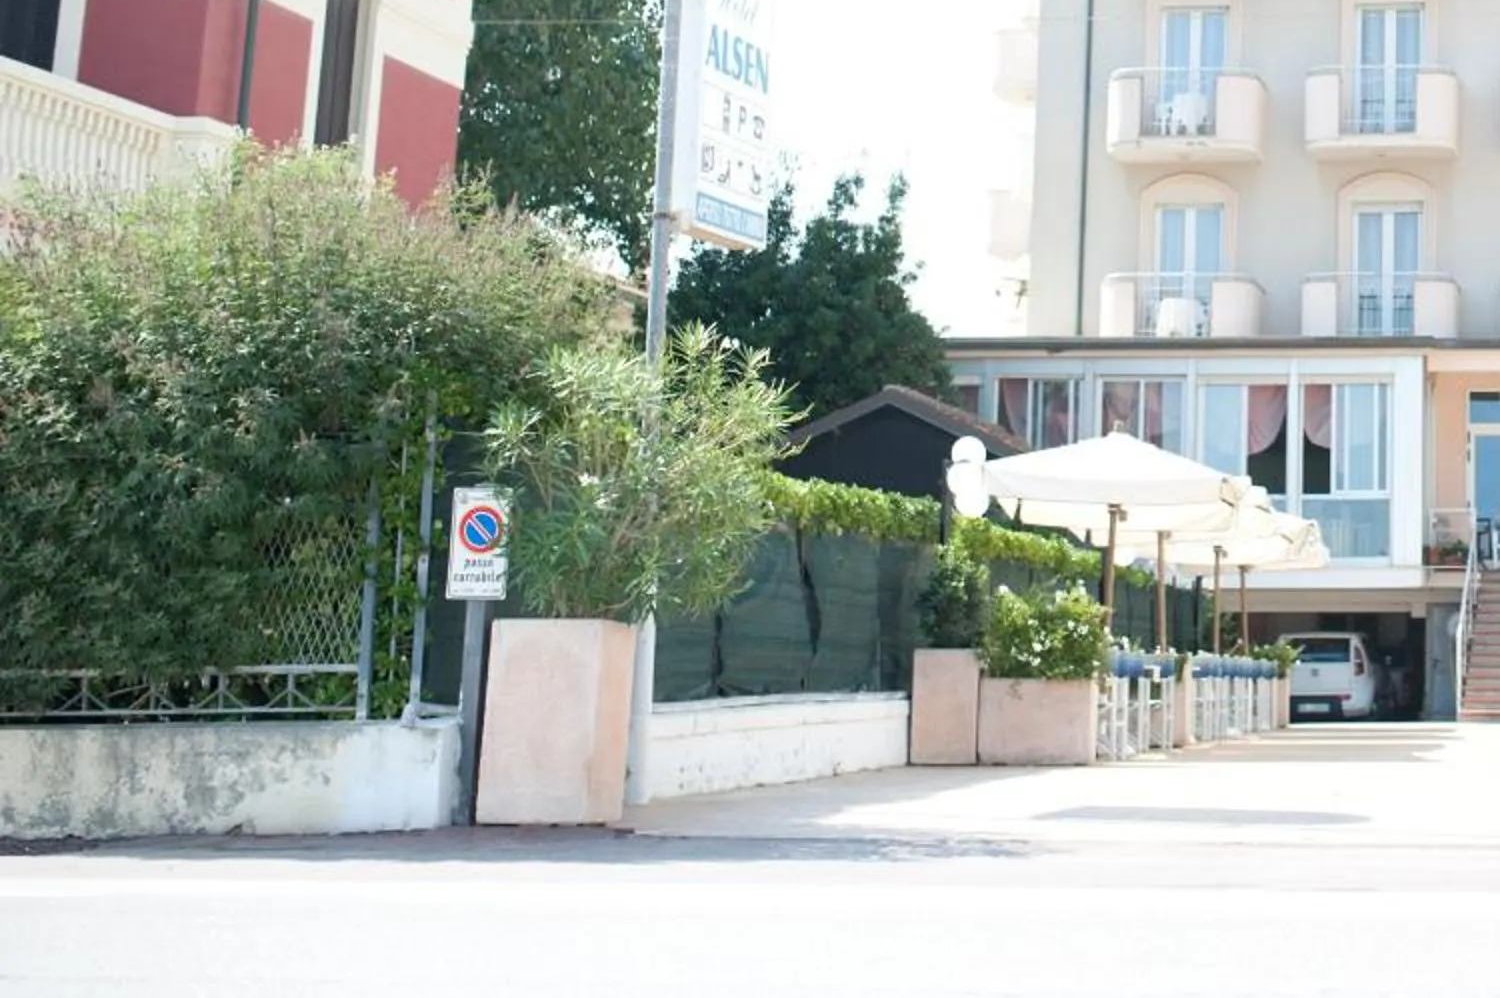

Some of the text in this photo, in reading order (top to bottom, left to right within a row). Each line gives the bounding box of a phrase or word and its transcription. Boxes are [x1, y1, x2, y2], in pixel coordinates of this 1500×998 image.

[705, 23, 771, 95] ALSEN
[464, 558, 494, 569] passo
[453, 570, 501, 584] carrabile
